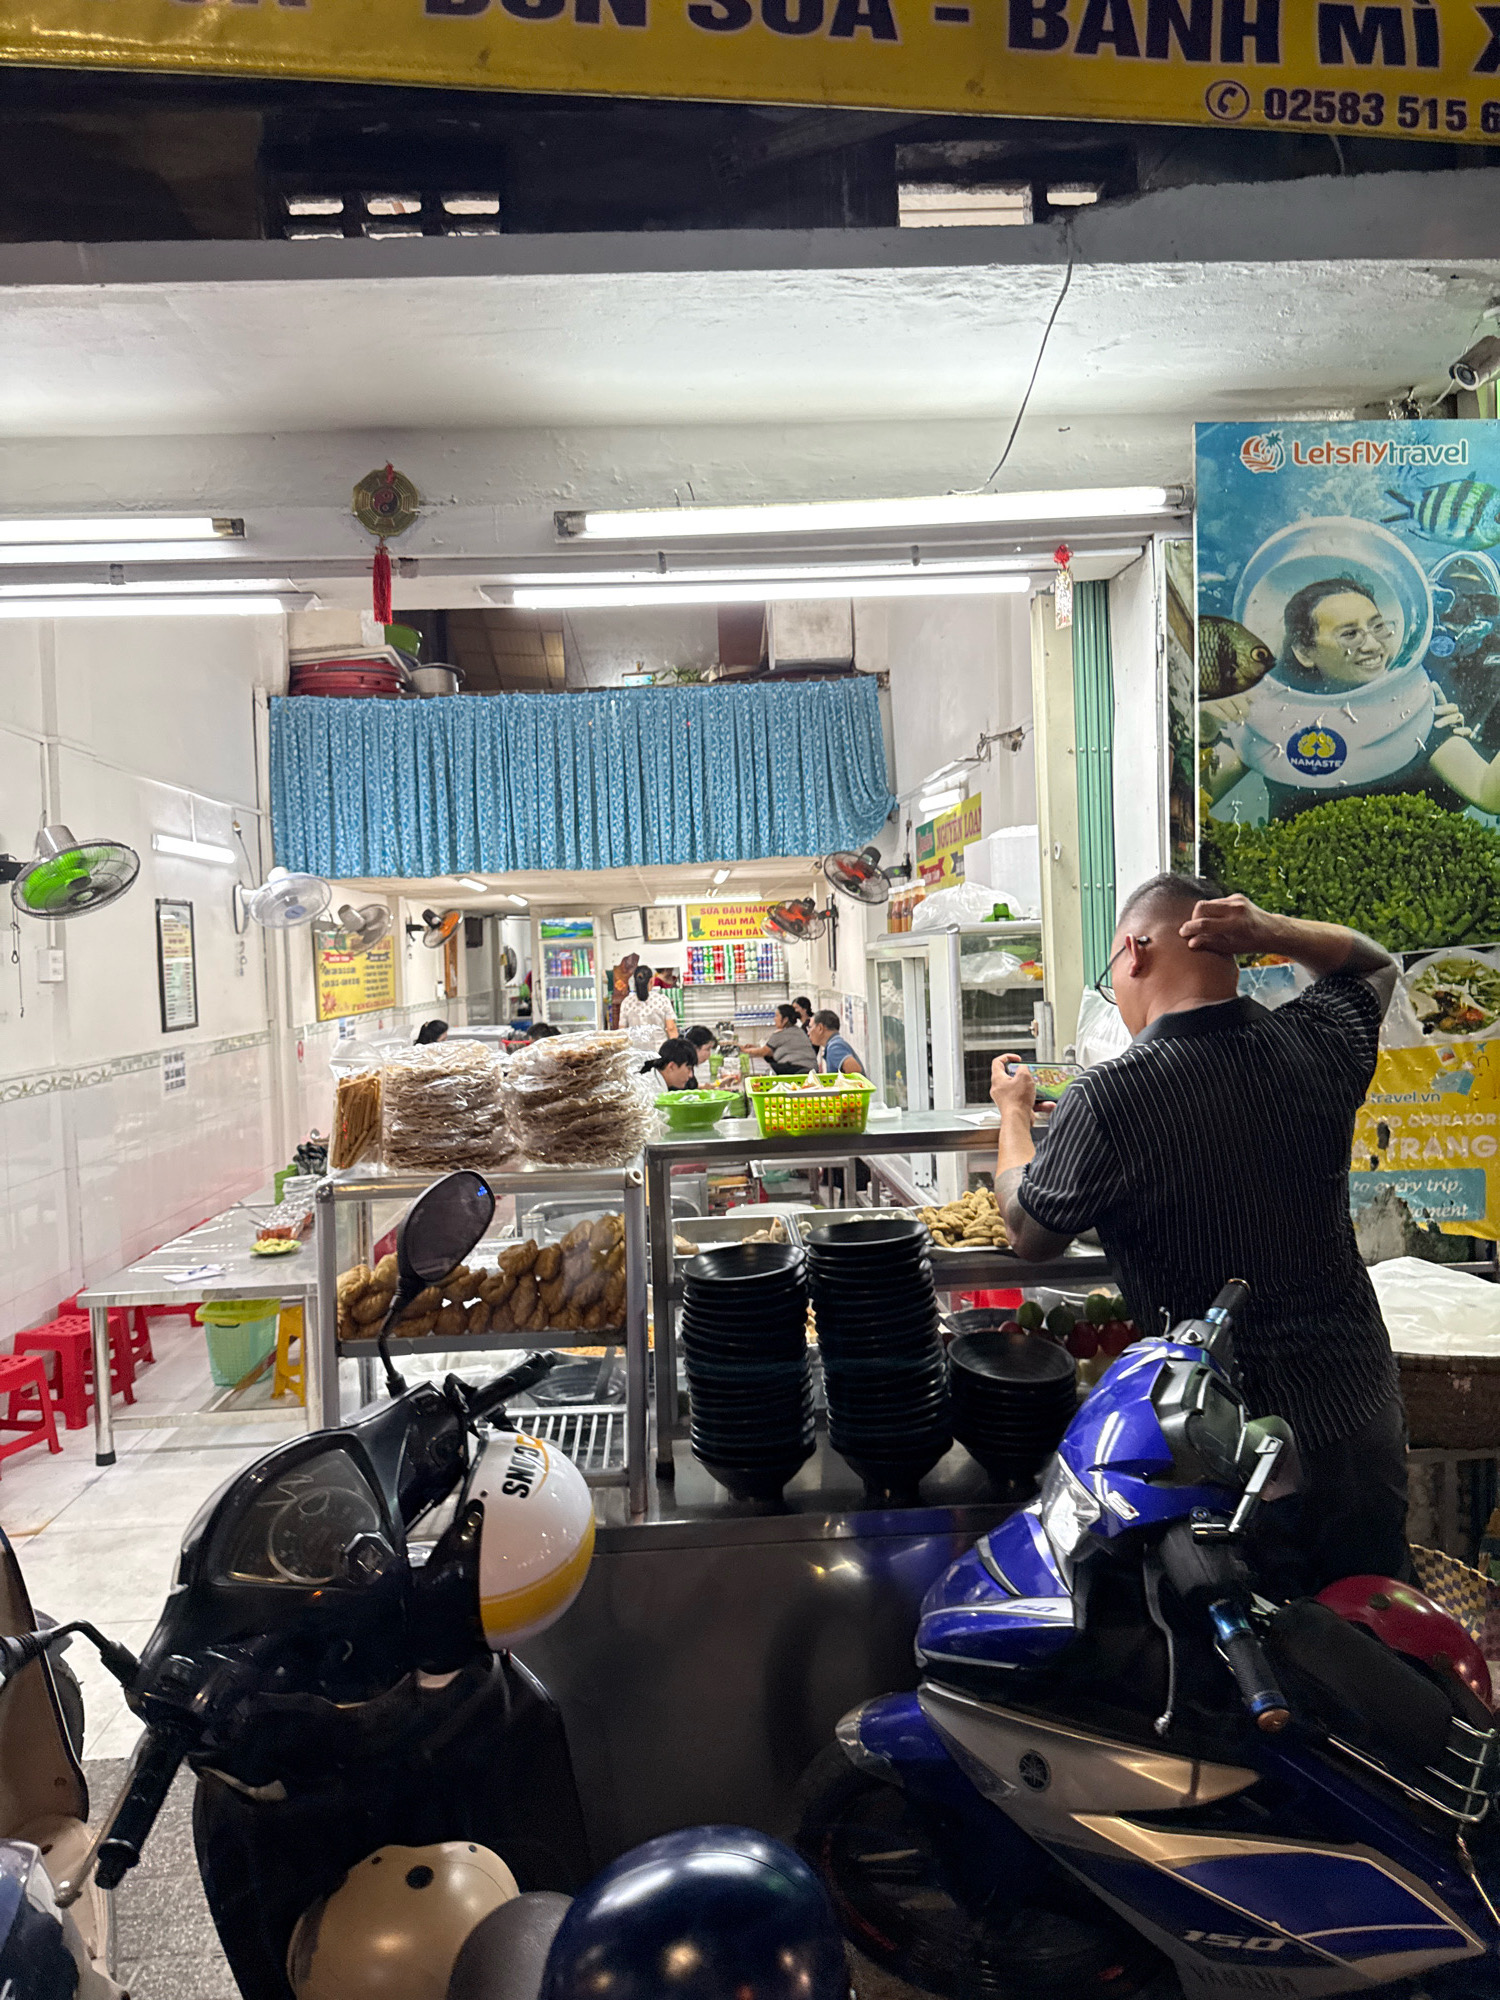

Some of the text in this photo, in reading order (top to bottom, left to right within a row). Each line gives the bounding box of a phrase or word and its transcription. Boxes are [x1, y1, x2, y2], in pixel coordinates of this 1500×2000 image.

[1263, 87, 1386, 127] 02583
[1397, 96, 1466, 131] 515
[1293, 438, 1469, 467] Letsflytravel
[1289, 755, 1343, 768] NAMASTE
[718, 918, 737, 926] RAU
[709, 929, 743, 938] CHANH
